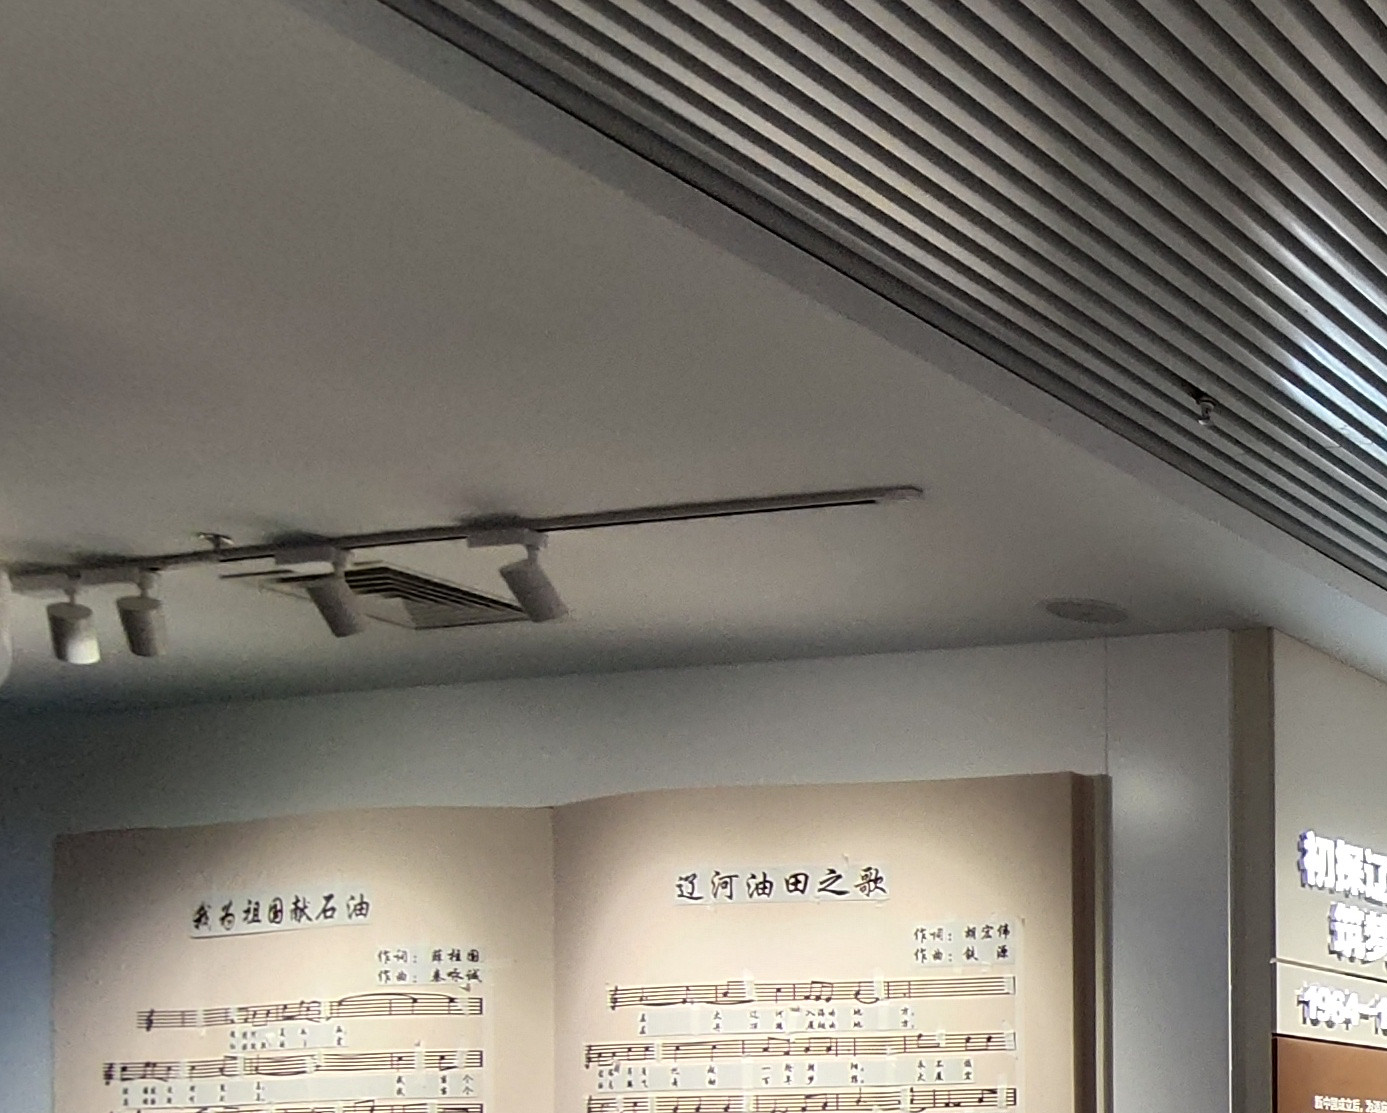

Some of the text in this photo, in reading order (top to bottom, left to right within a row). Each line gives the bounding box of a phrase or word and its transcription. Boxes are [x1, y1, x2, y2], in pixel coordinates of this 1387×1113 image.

[676, 866, 889, 901] 辽河油田之歌
[192, 893, 371, 931] 我为祖国献石油
